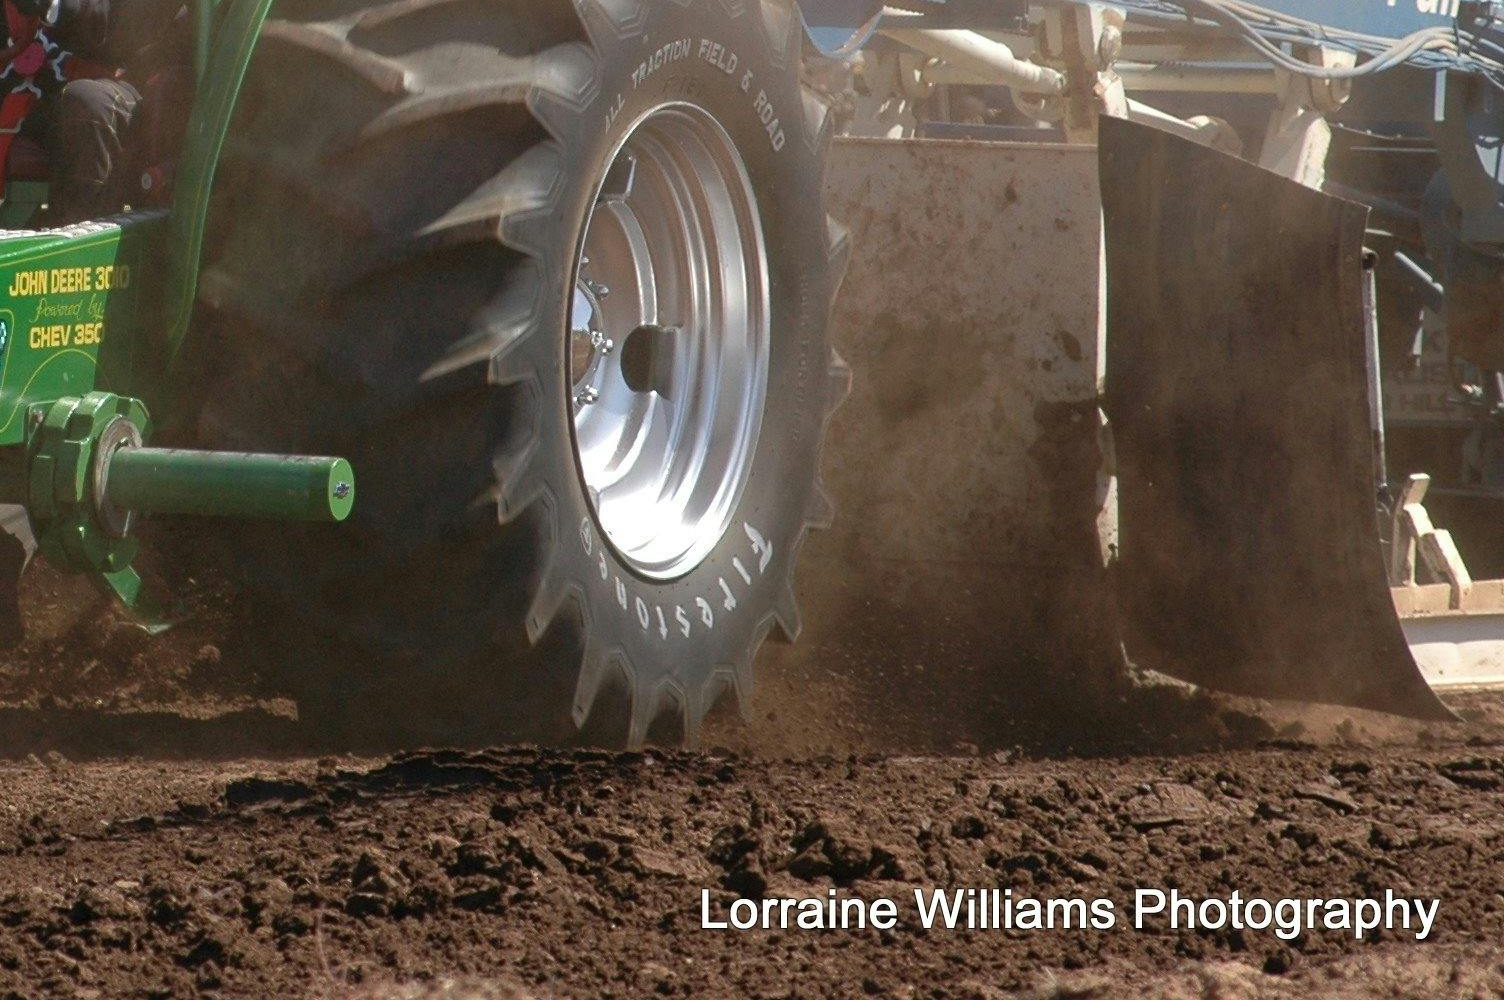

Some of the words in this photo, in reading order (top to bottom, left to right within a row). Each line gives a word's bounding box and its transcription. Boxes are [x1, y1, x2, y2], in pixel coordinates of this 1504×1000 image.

[631, 38, 692, 88] TRACTION
[698, 39, 738, 74] FIELD
[753, 89, 786, 152] ROAD
[9, 269, 48, 297] JOHN
[51, 266, 91, 294] DEERE
[29, 323, 71, 349] CHEV
[74, 322, 104, 345] 350
[598, 521, 773, 640] Firestone
